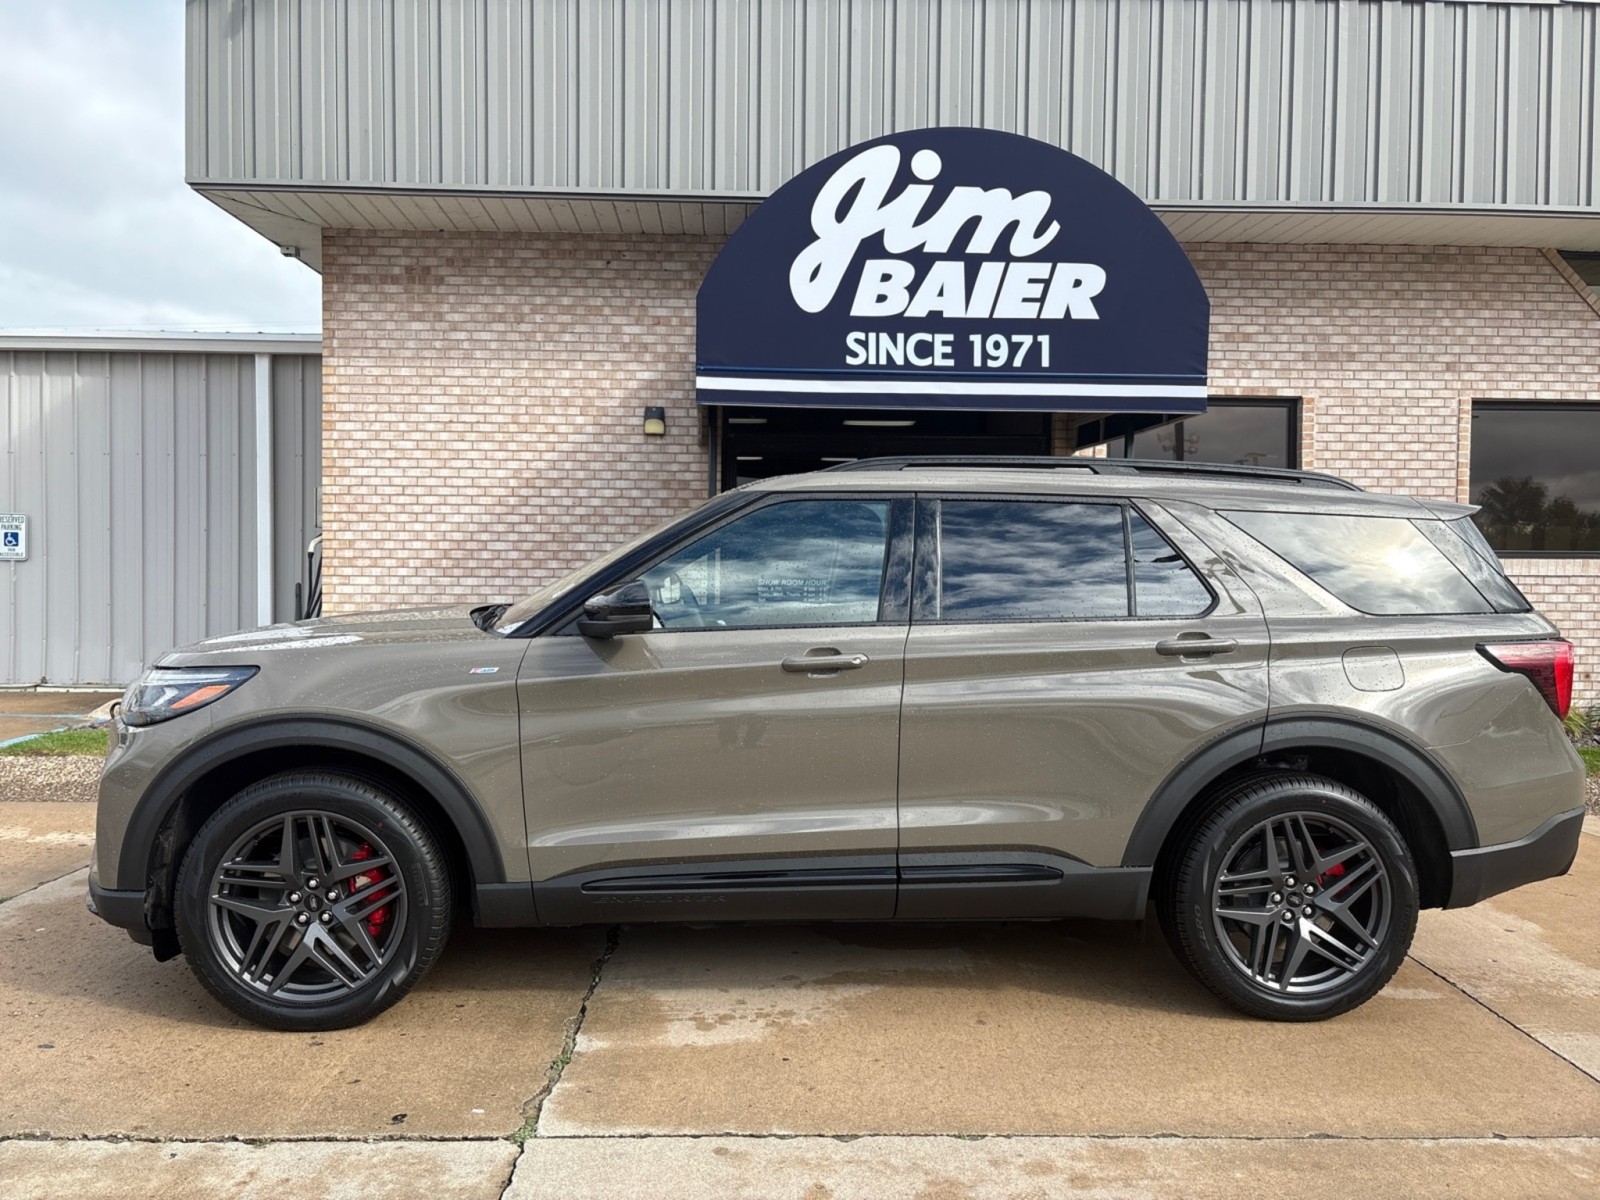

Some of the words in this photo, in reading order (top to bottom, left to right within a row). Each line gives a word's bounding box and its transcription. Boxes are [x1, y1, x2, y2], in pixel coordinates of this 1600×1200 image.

[789, 144, 1061, 313] Jim
[849, 259, 1107, 320] BAIER
[845, 331, 955, 367] SINCE
[969, 333, 1051, 368] 1971
